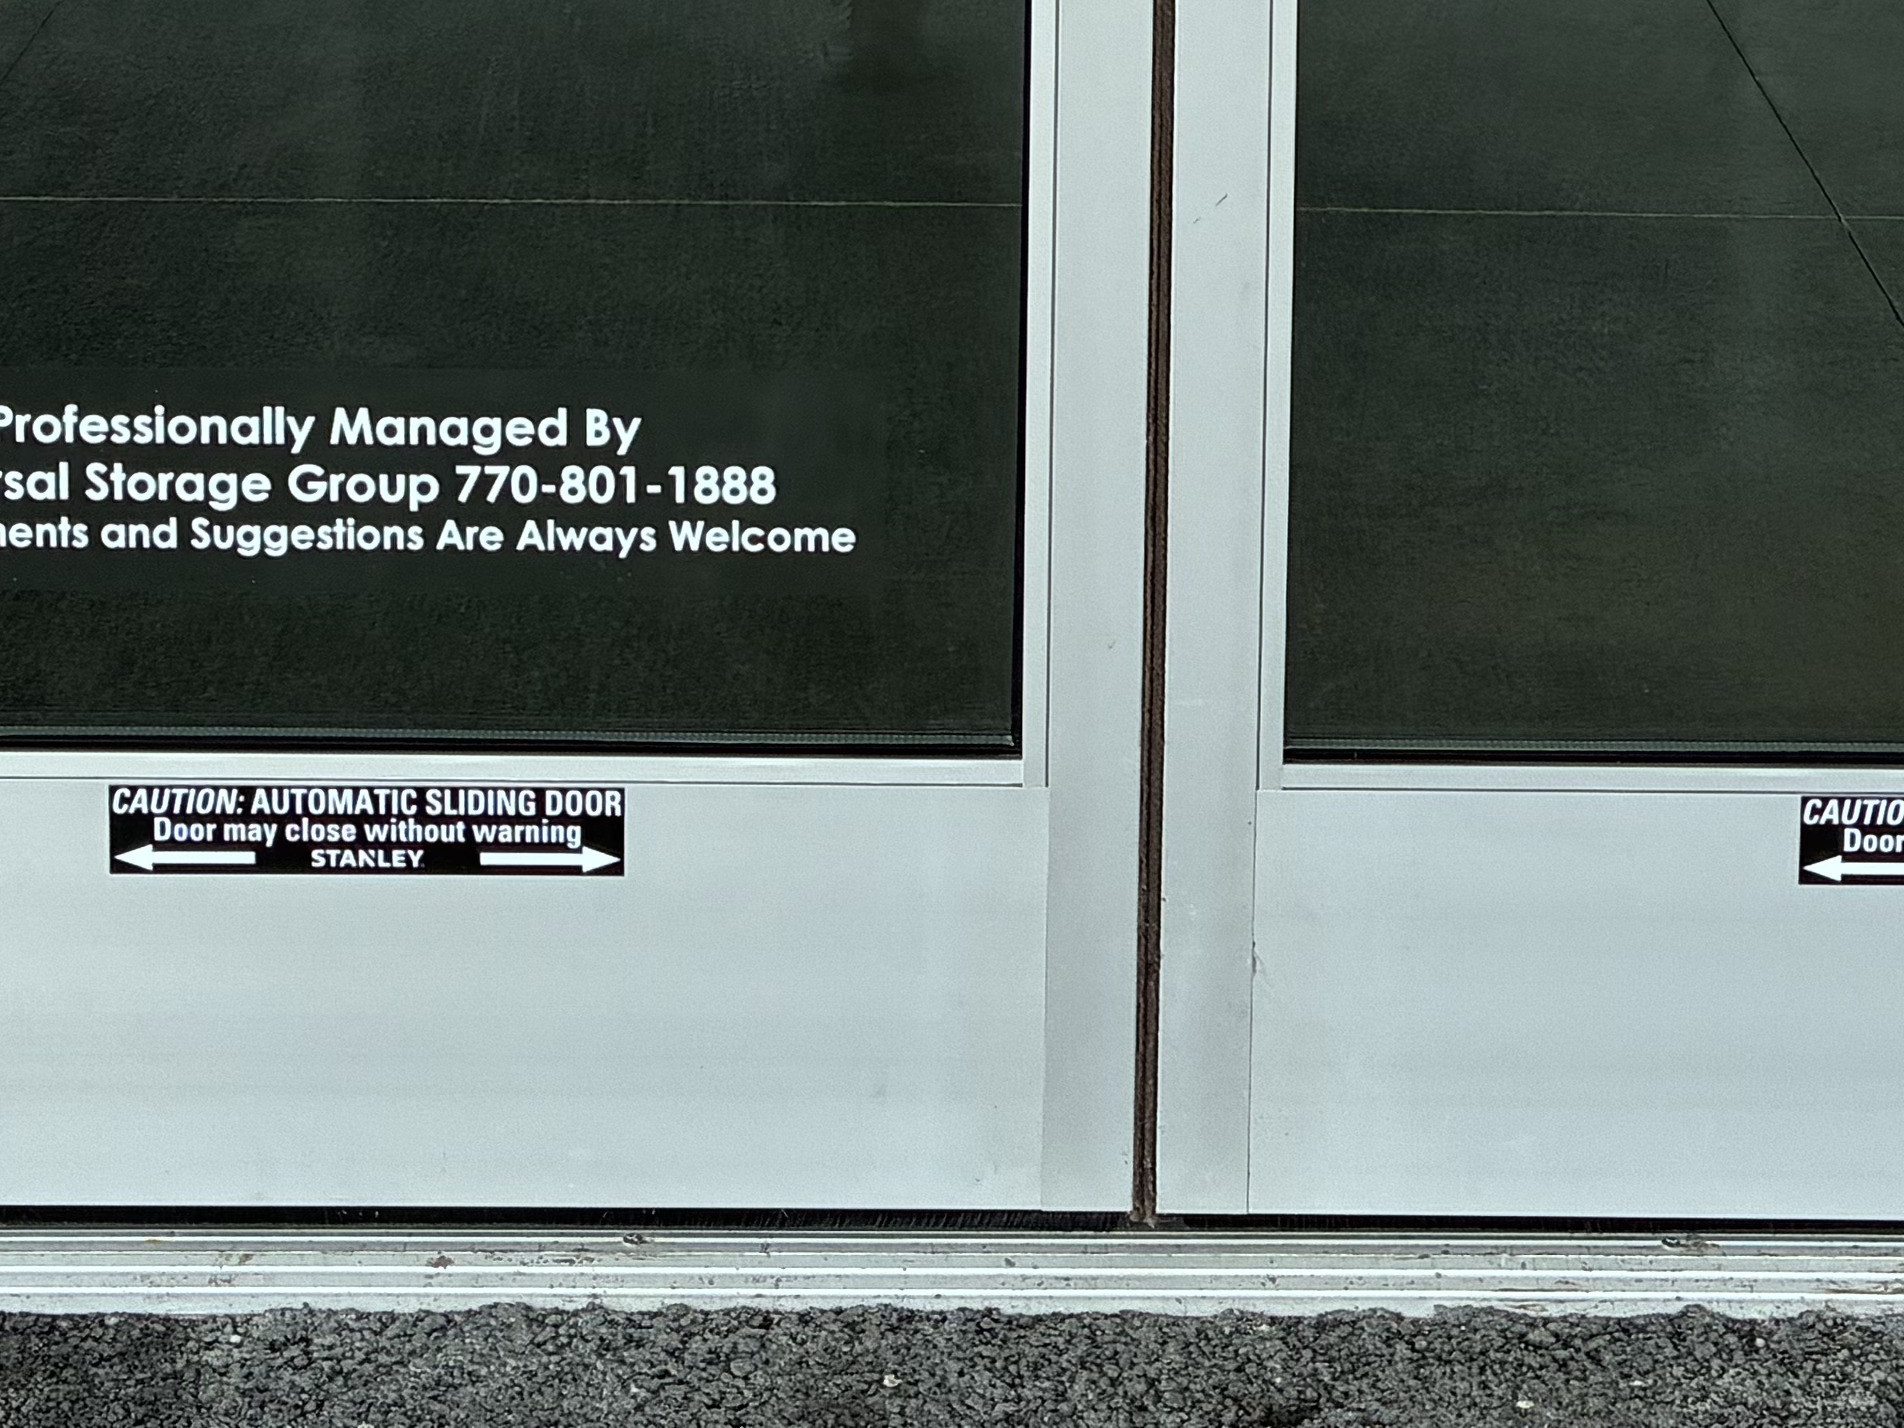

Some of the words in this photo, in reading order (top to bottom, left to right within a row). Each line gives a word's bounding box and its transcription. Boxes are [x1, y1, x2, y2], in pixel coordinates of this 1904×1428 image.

[329, 406, 568, 456] Managed
[585, 408, 642, 456] By
[84, 462, 272, 510] Storage
[287, 463, 440, 512] Group
[455, 464, 777, 505] 770-801-1888
[100, 516, 178, 549] and
[190, 516, 424, 557] Suggestions
[436, 519, 505, 551] Are
[515, 518, 657, 559] Always
[668, 519, 856, 553] Welcome
[112, 788, 245, 816] CAUTION:
[249, 788, 419, 817] AUTOMATIC
[423, 789, 537, 817] SLIDING
[544, 790, 622, 817] DOOR
[153, 818, 217, 842] Door
[222, 821, 278, 846] may
[284, 818, 358, 843] close
[364, 818, 467, 844] without
[471, 820, 582, 848] warning
[310, 849, 425, 868] STANLEY
